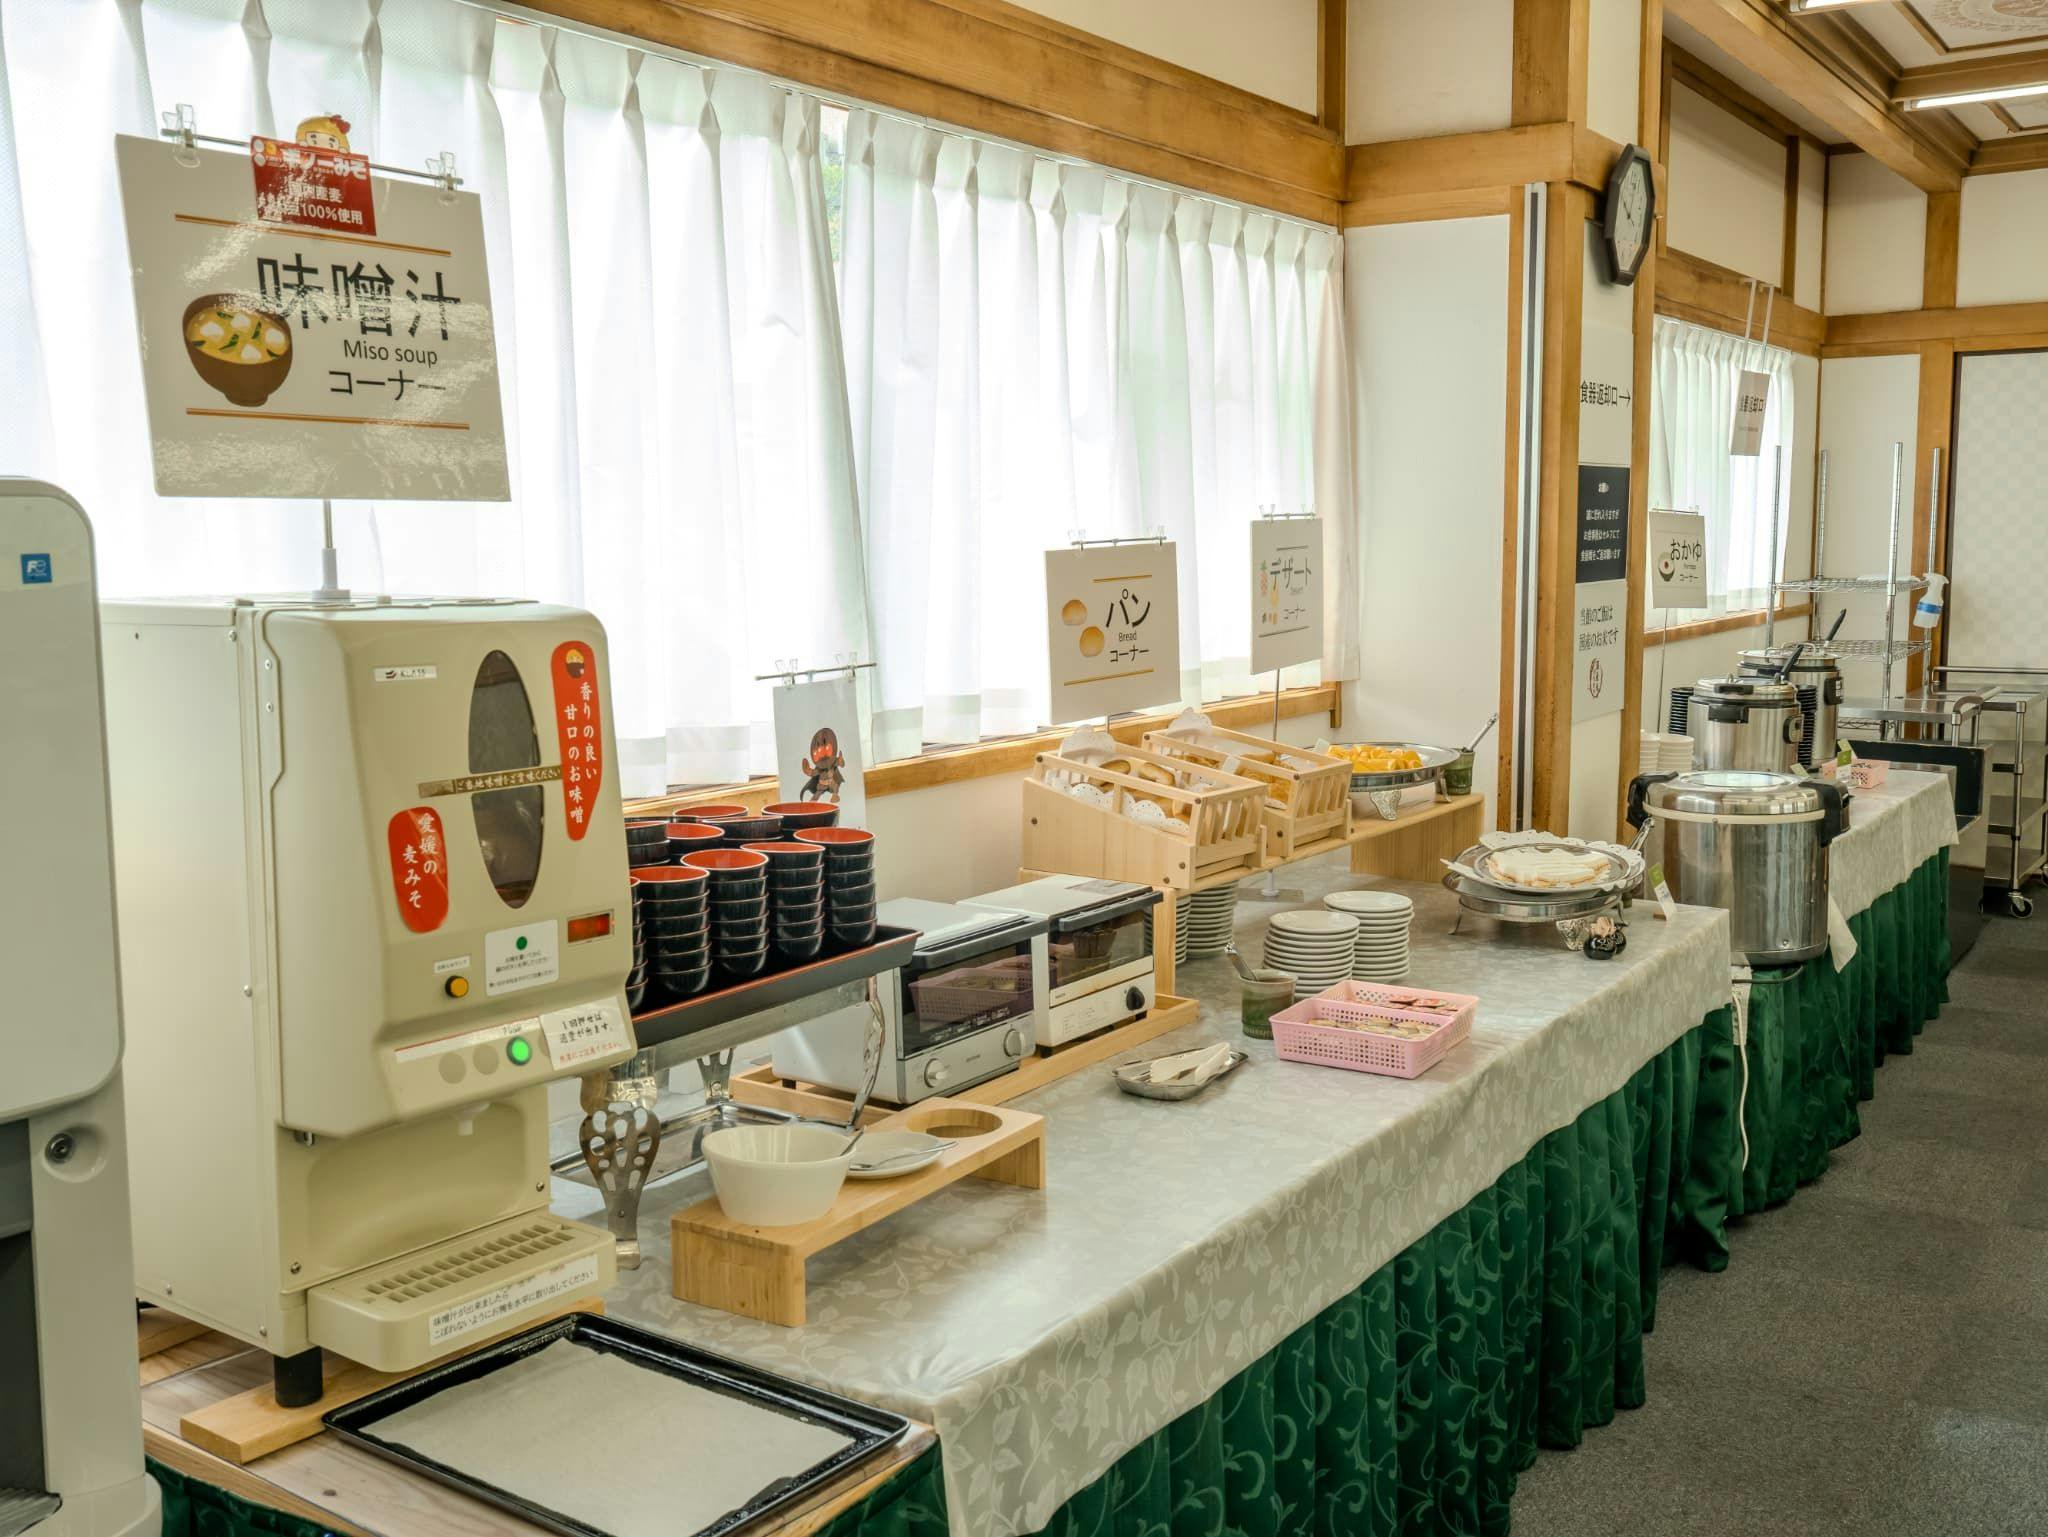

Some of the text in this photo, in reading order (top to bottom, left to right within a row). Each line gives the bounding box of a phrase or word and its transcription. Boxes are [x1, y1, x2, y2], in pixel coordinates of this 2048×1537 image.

[257, 252, 462, 341] 味噌汁
[343, 338, 438, 368] Miso soup
[328, 369, 447, 401] コーナー
[1580, 380, 1618, 406] 食器返却口
[1670, 537, 1702, 561] おかゆ
[1270, 557, 1312, 591] デザート
[1106, 588, 1151, 628] パン
[1110, 644, 1150, 663] コーナー
[1118, 631, 1138, 643] Bread
[580, 681, 598, 779] 香りの良い
[564, 703, 583, 823] 甘口のお味噌
[418, 812, 437, 874] 愛媛の
[402, 844, 422, 909] 麦みそ
